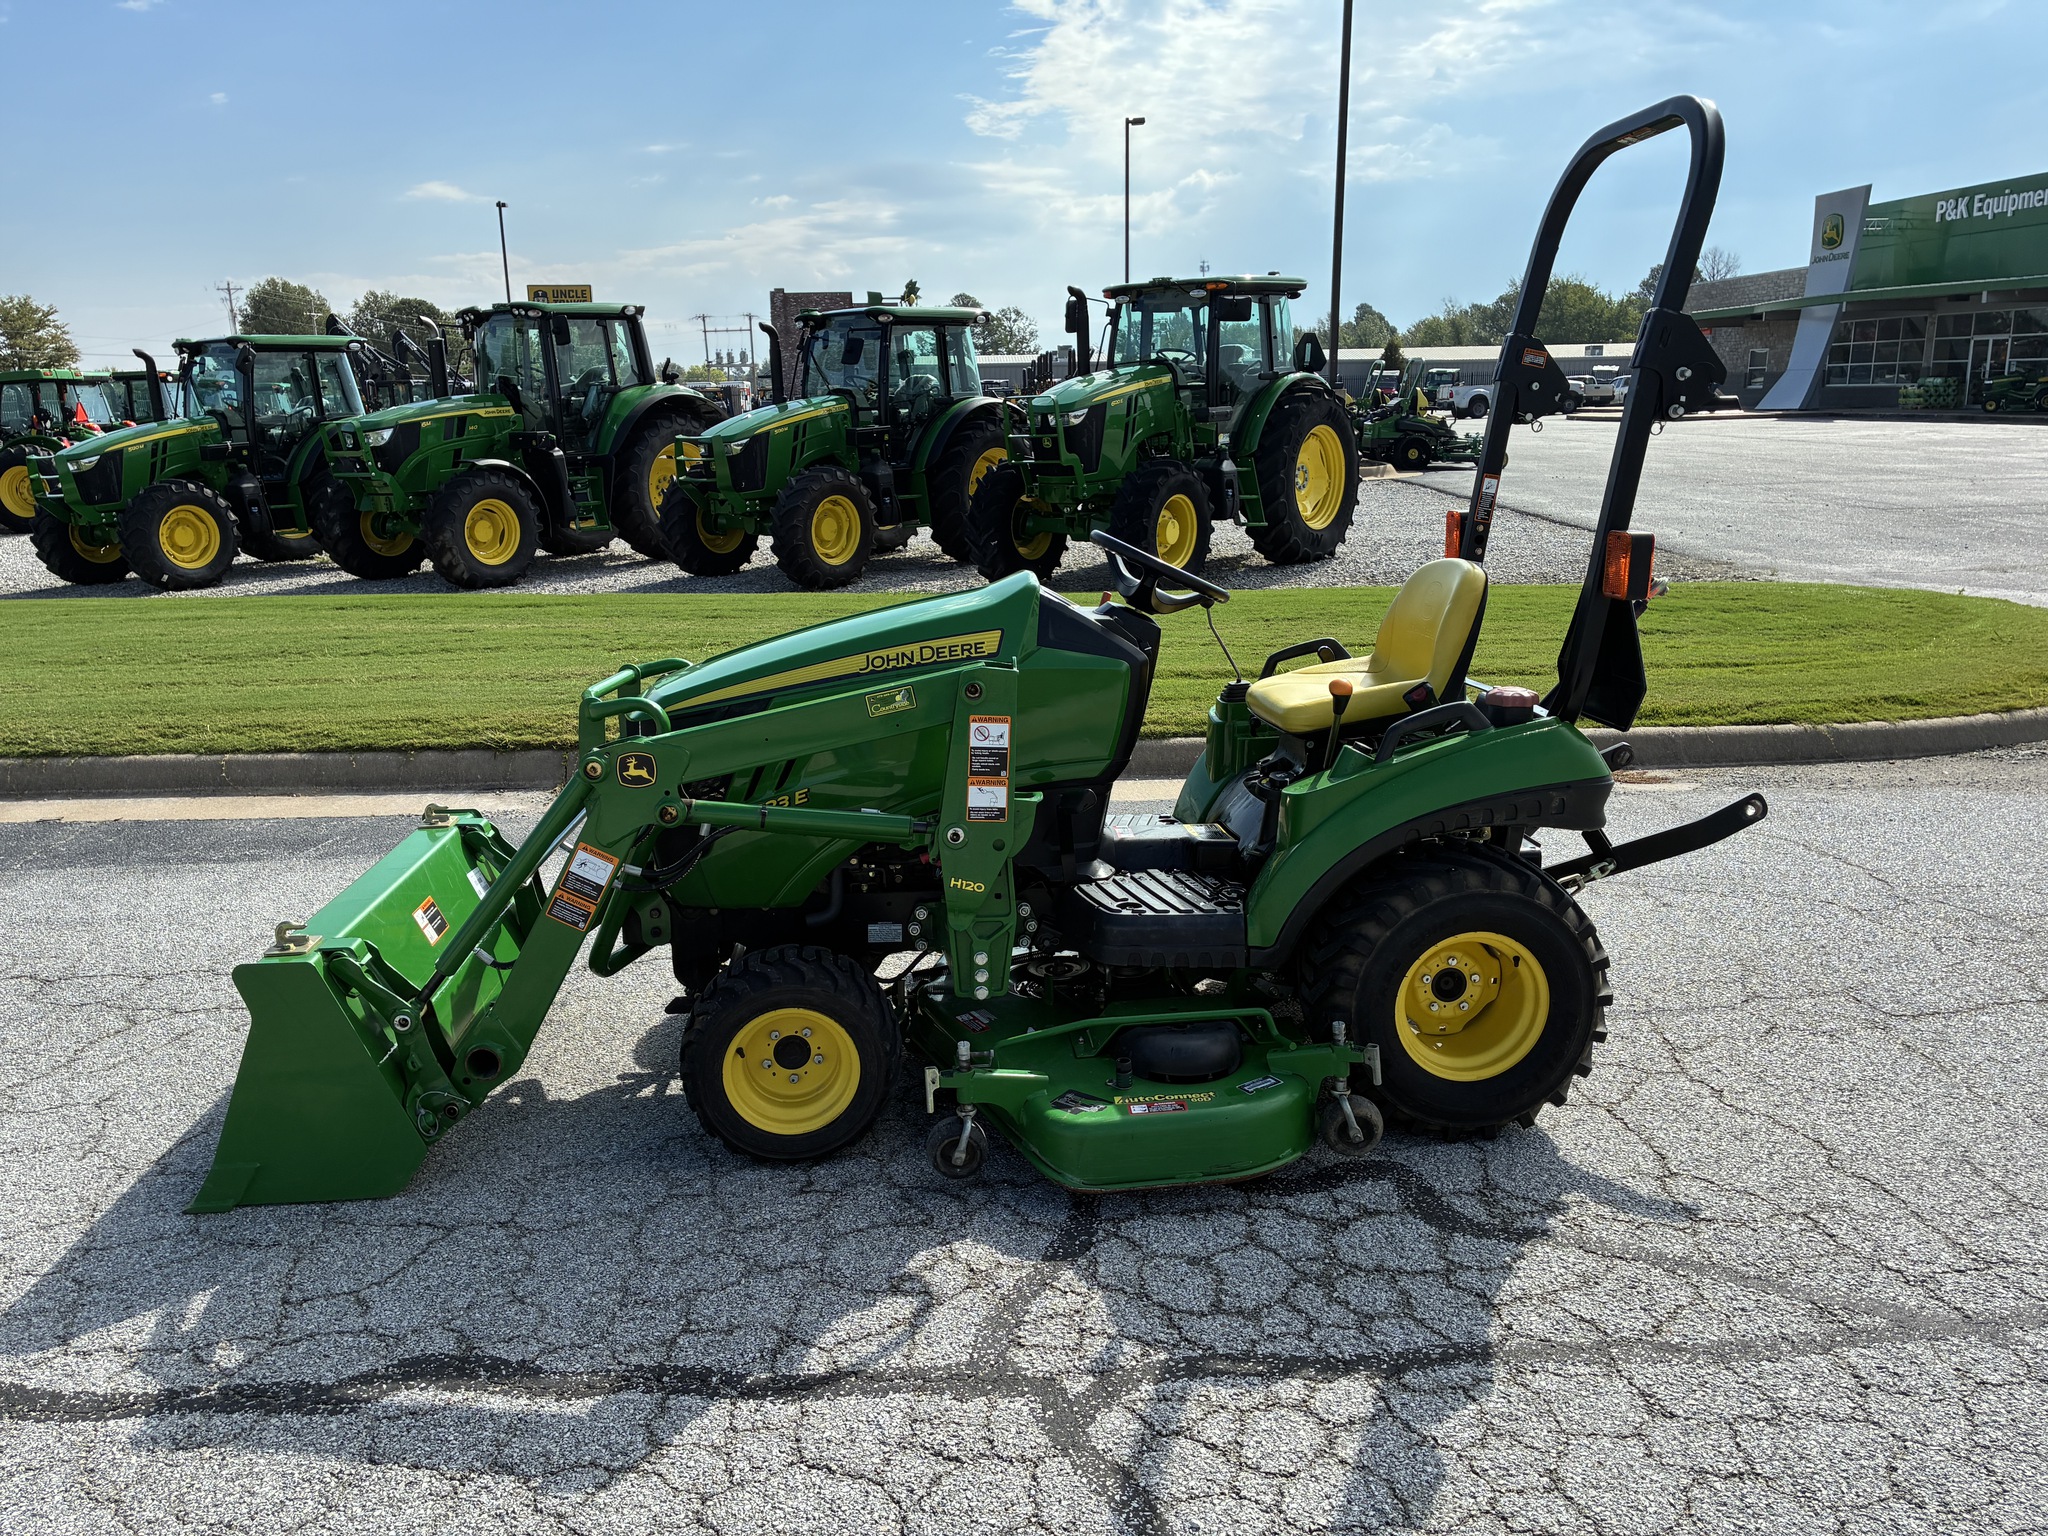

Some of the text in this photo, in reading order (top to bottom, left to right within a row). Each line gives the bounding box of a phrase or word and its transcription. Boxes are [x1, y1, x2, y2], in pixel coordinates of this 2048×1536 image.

[1935, 195, 1970, 223] P&K
[1811, 250, 1850, 265] JOHN DEERE
[552, 289, 587, 299] UNCLE
[858, 641, 986, 672] JOHN DEERE
[588, 847, 614, 863] WARNING
[950, 877, 985, 893] H120
[566, 896, 591, 910] WARNING
